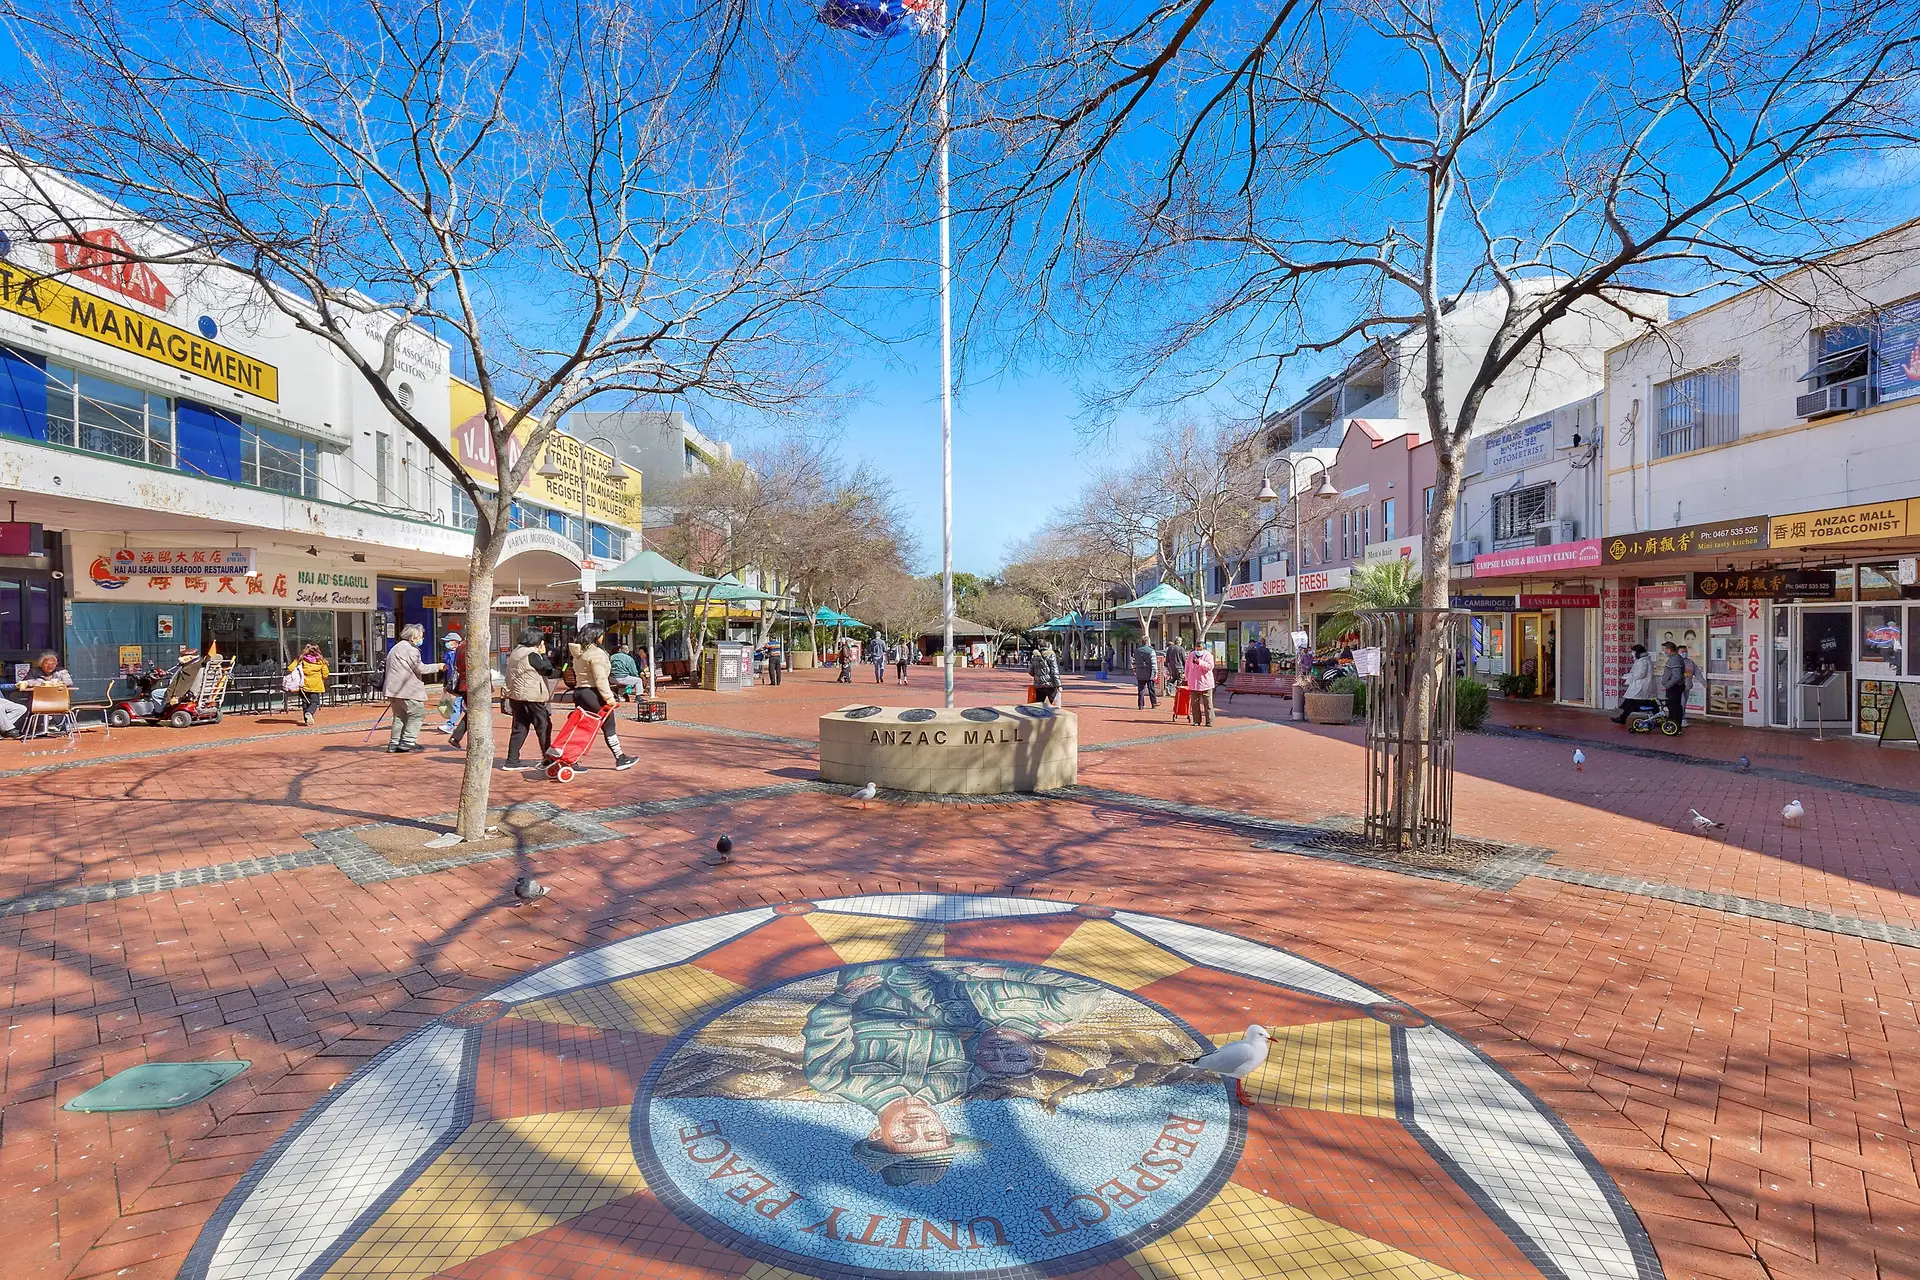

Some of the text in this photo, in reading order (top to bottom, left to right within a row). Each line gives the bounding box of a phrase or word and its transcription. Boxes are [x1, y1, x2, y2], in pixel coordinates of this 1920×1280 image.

[70, 295, 263, 391] MANAGEMENT
[402, 346, 442, 374] ASSOCIATES
[1524, 420, 1552, 437] SPECS
[551, 449, 578, 473] TRATA
[1493, 444, 1544, 466] OPTOMETRIST
[546, 479, 628, 519] REGISTEED VALUERS
[590, 481, 636, 509] MANAGEMENT
[1814, 510, 1896, 527] ANZAC MALL
[1700, 525, 1759, 540] Ph: 0467 535 525
[1773, 521, 1806, 540] 香烟
[1810, 520, 1901, 538] TOBACCONIST
[1367, 549, 1382, 560] Men's
[1382, 547, 1393, 557] hair
[1697, 538, 1758, 550] Mini tasty kitchen
[114, 565, 249, 574] HAI AU SEAGULL SEAFOOD RESTAURANT
[1476, 559, 1501, 570] CAMPSIE
[1501, 557, 1521, 567] LASER
[1520, 557, 1526, 565] &
[1526, 553, 1552, 566] BEAUTY
[1553, 550, 1577, 562] CLINIC
[297, 570, 369, 589] HAI AU SEAGULL
[1229, 572, 1329, 599] CAMPSIE SUPER FRESH
[296, 589, 370, 606] Seafood Restaurant
[1464, 599, 1506, 608] CAMBRIDGE
[1748, 599, 1760, 619] AX
[1866, 630, 1901, 641] OPEN
[1821, 641, 1837, 650] OPEN
[1747, 634, 1760, 713] FACIAL
[870, 728, 1024, 746] ANZAC MALL
[679, 1112, 1207, 1251] RESPECT UNITY PEACE
